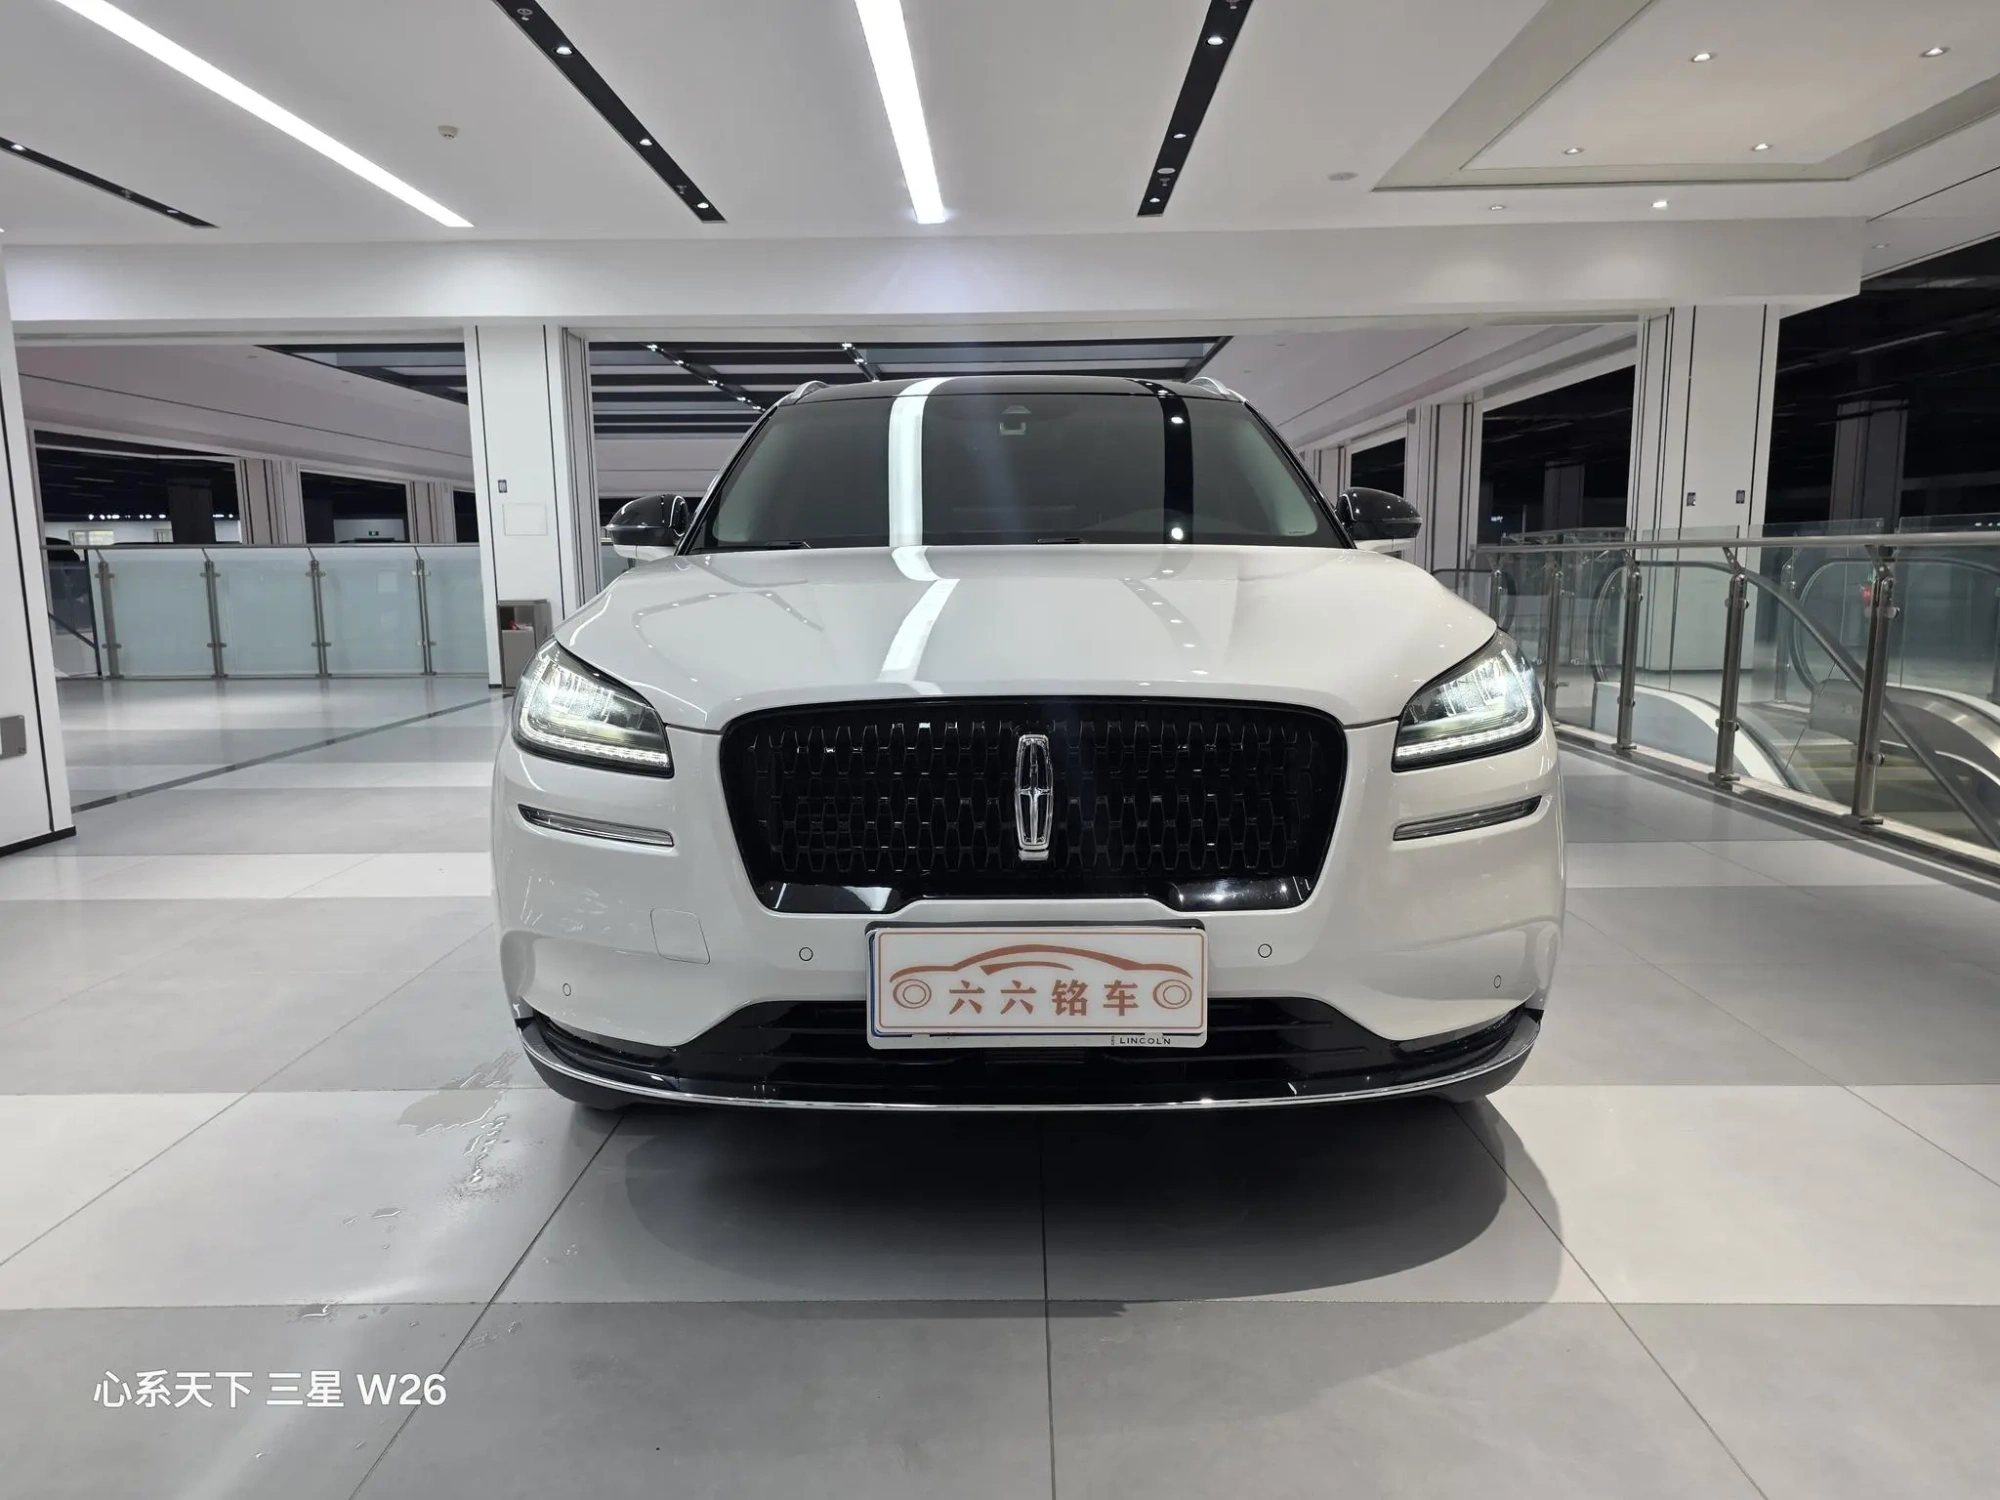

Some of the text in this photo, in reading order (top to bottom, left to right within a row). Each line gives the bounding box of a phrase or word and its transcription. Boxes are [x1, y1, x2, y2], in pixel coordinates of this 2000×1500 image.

[948, 979, 1139, 1017] 六六铭车
[1119, 1037, 1171, 1045] LINCOLN
